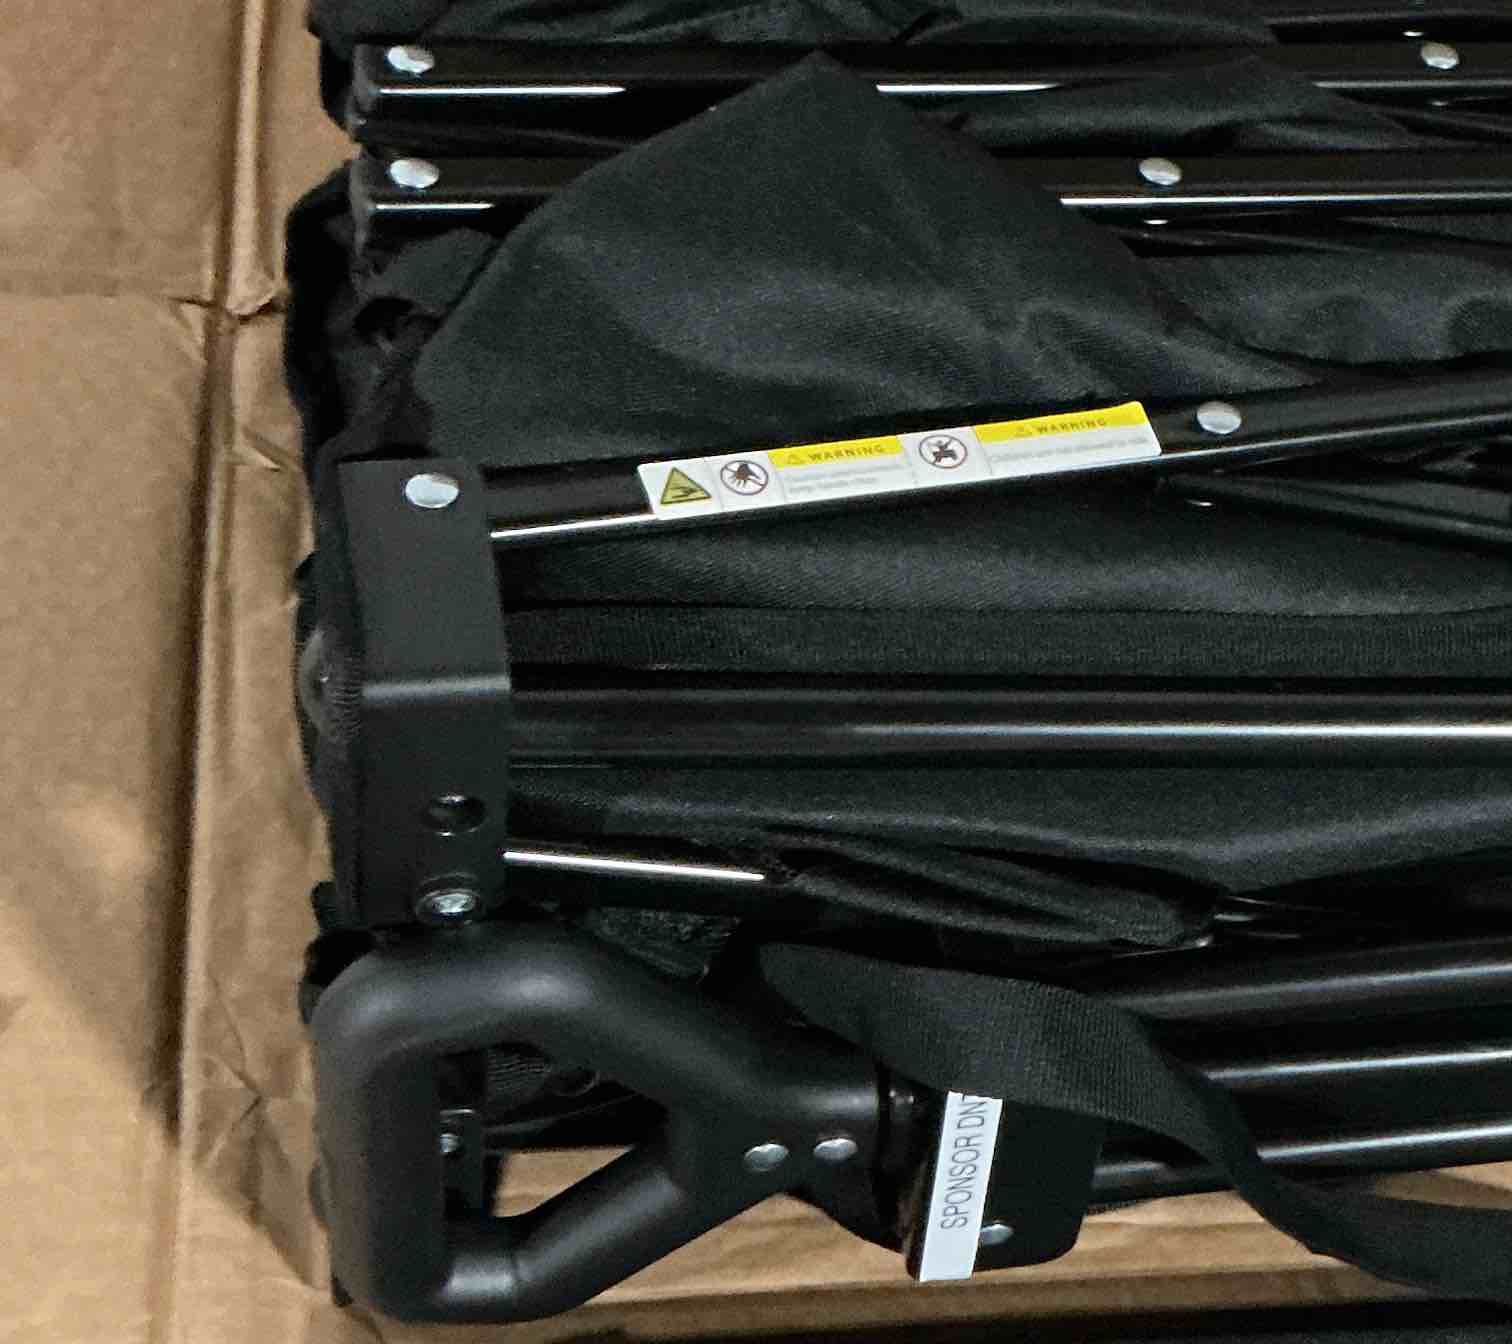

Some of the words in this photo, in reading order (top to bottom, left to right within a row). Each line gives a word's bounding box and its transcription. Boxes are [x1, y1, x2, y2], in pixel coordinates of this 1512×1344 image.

[1036, 417, 1108, 435] WARNING
[807, 443, 886, 463] WARNING
[957, 1092, 988, 1130] DN
[940, 1133, 983, 1230] SPONSOR
